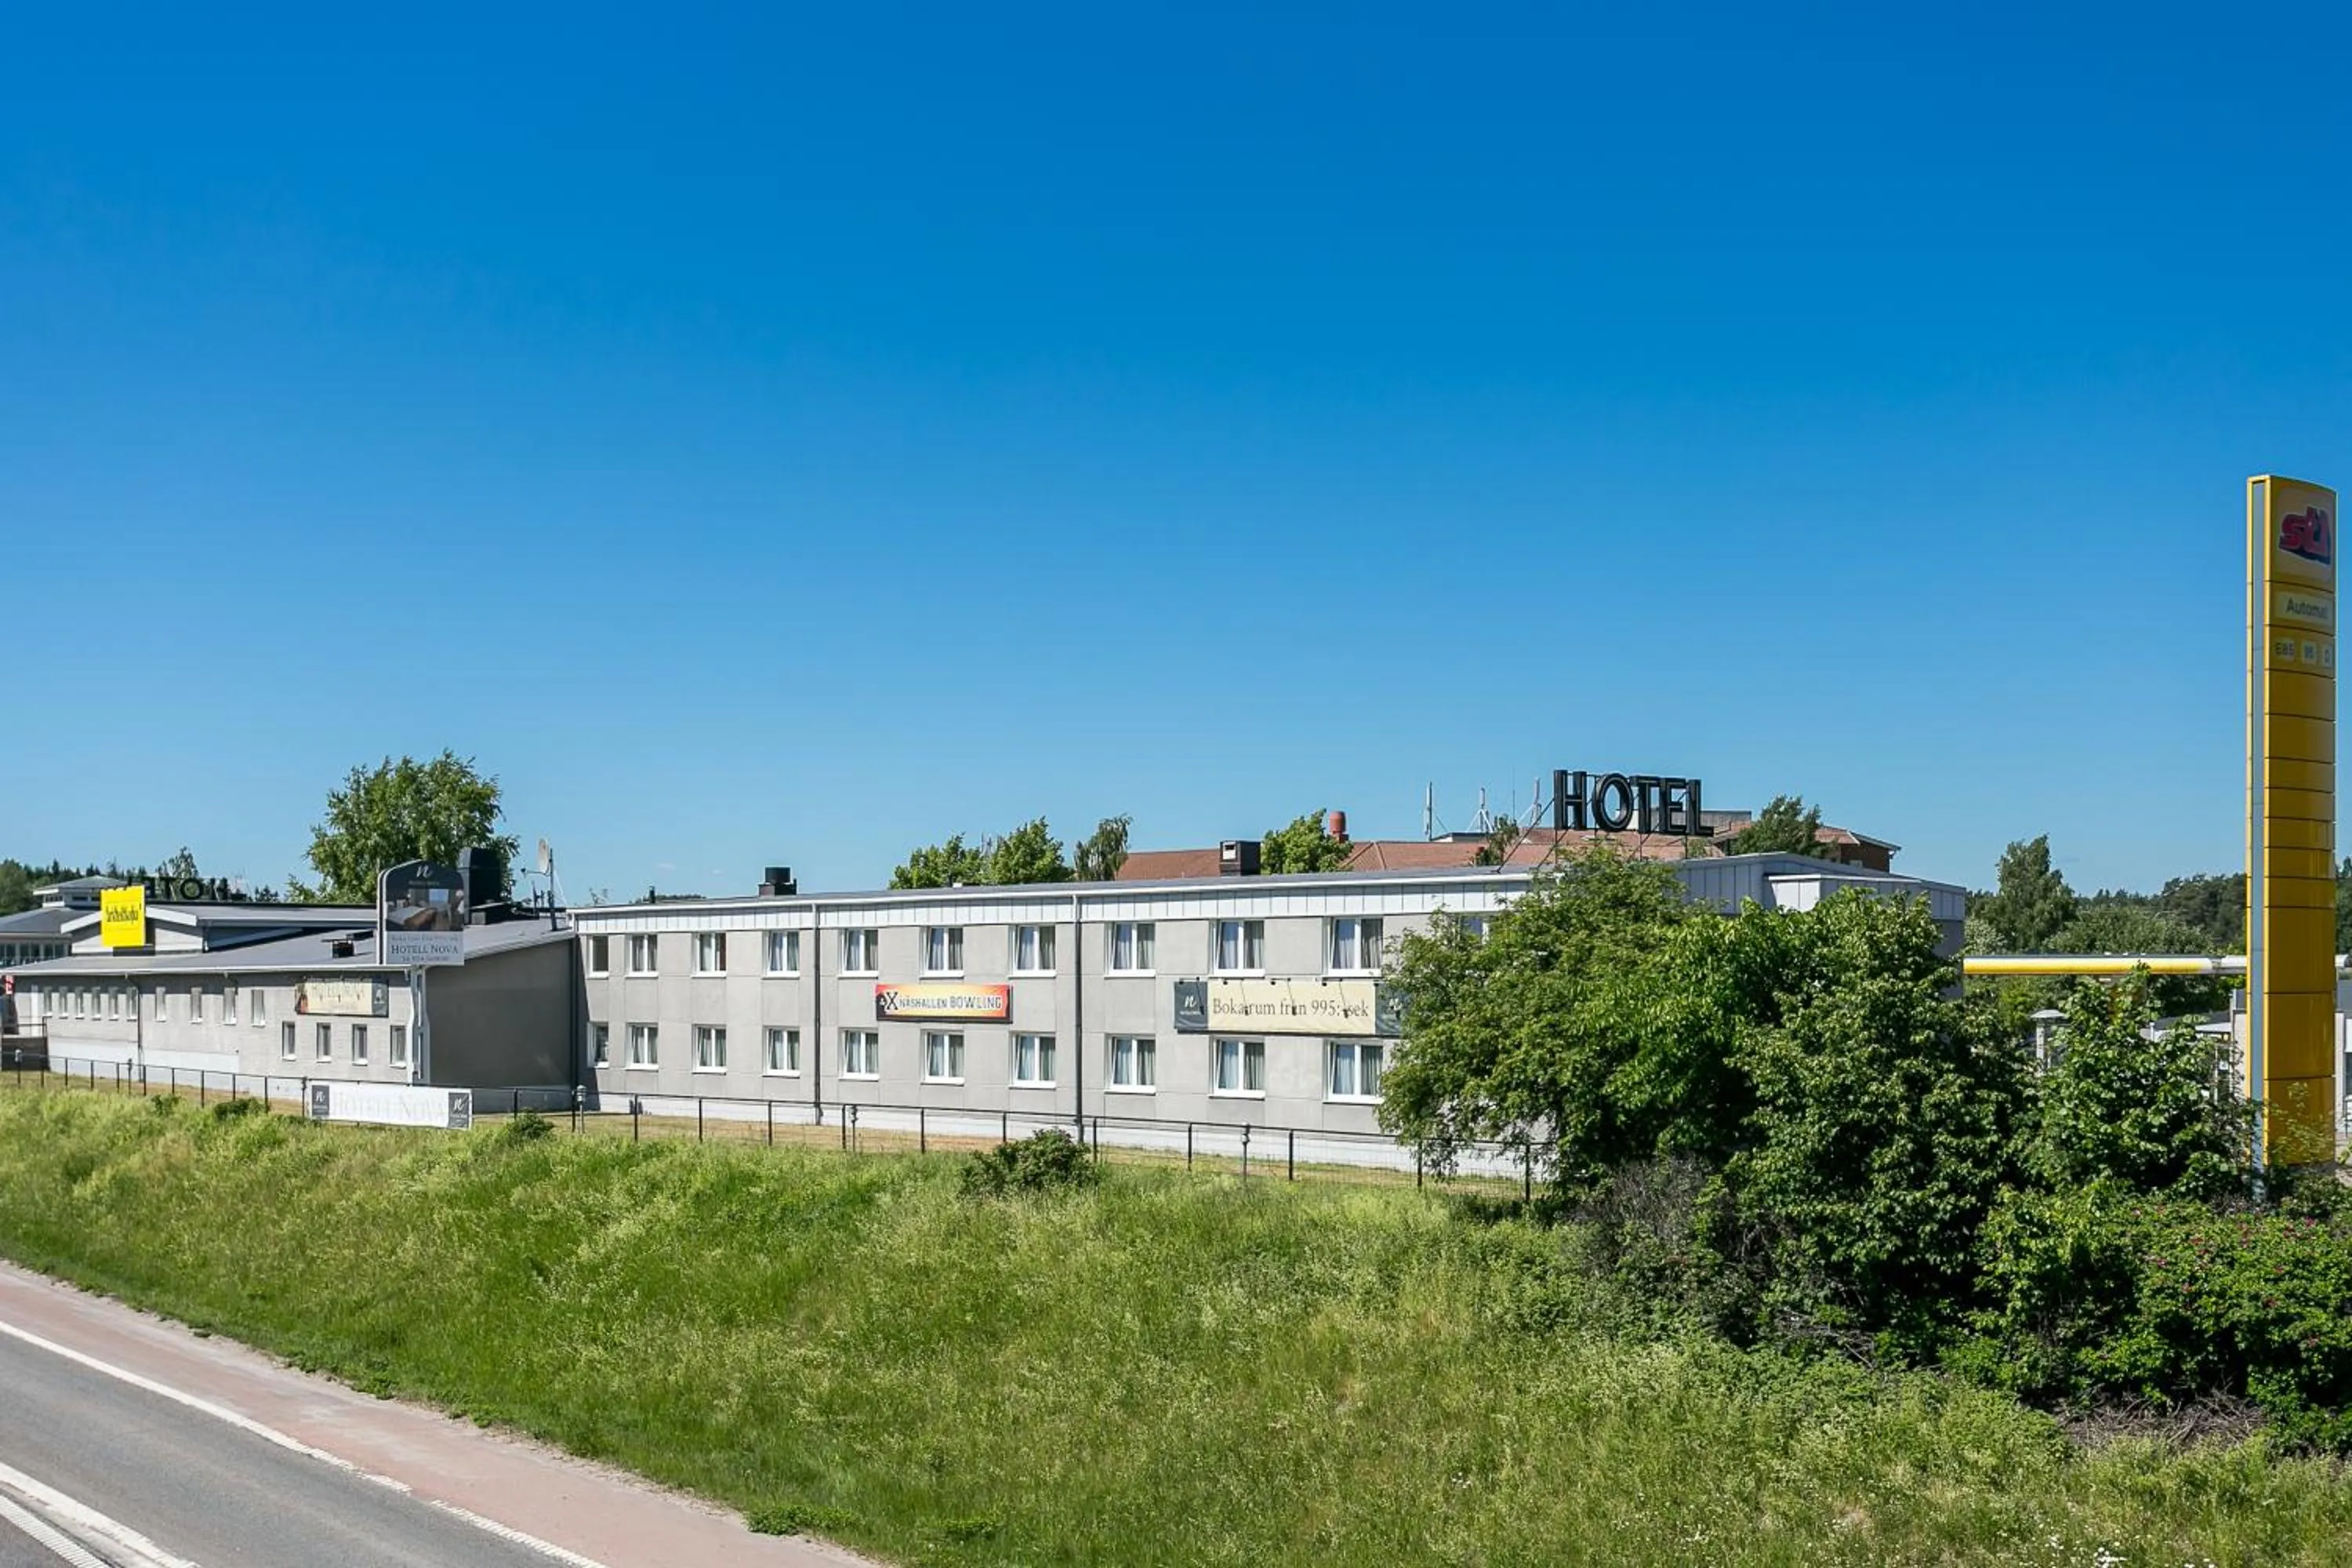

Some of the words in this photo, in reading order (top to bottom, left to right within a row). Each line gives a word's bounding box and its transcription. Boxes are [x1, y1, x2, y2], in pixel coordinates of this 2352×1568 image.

[1554, 769, 1715, 837] HOTEL
[430, 943, 459, 955] NOVA
[949, 995, 1001, 1009] BOWLING
[1213, 997, 1245, 1014] Boka
[1249, 1003, 1276, 1015] rum
[1280, 998, 1307, 1016] frn
